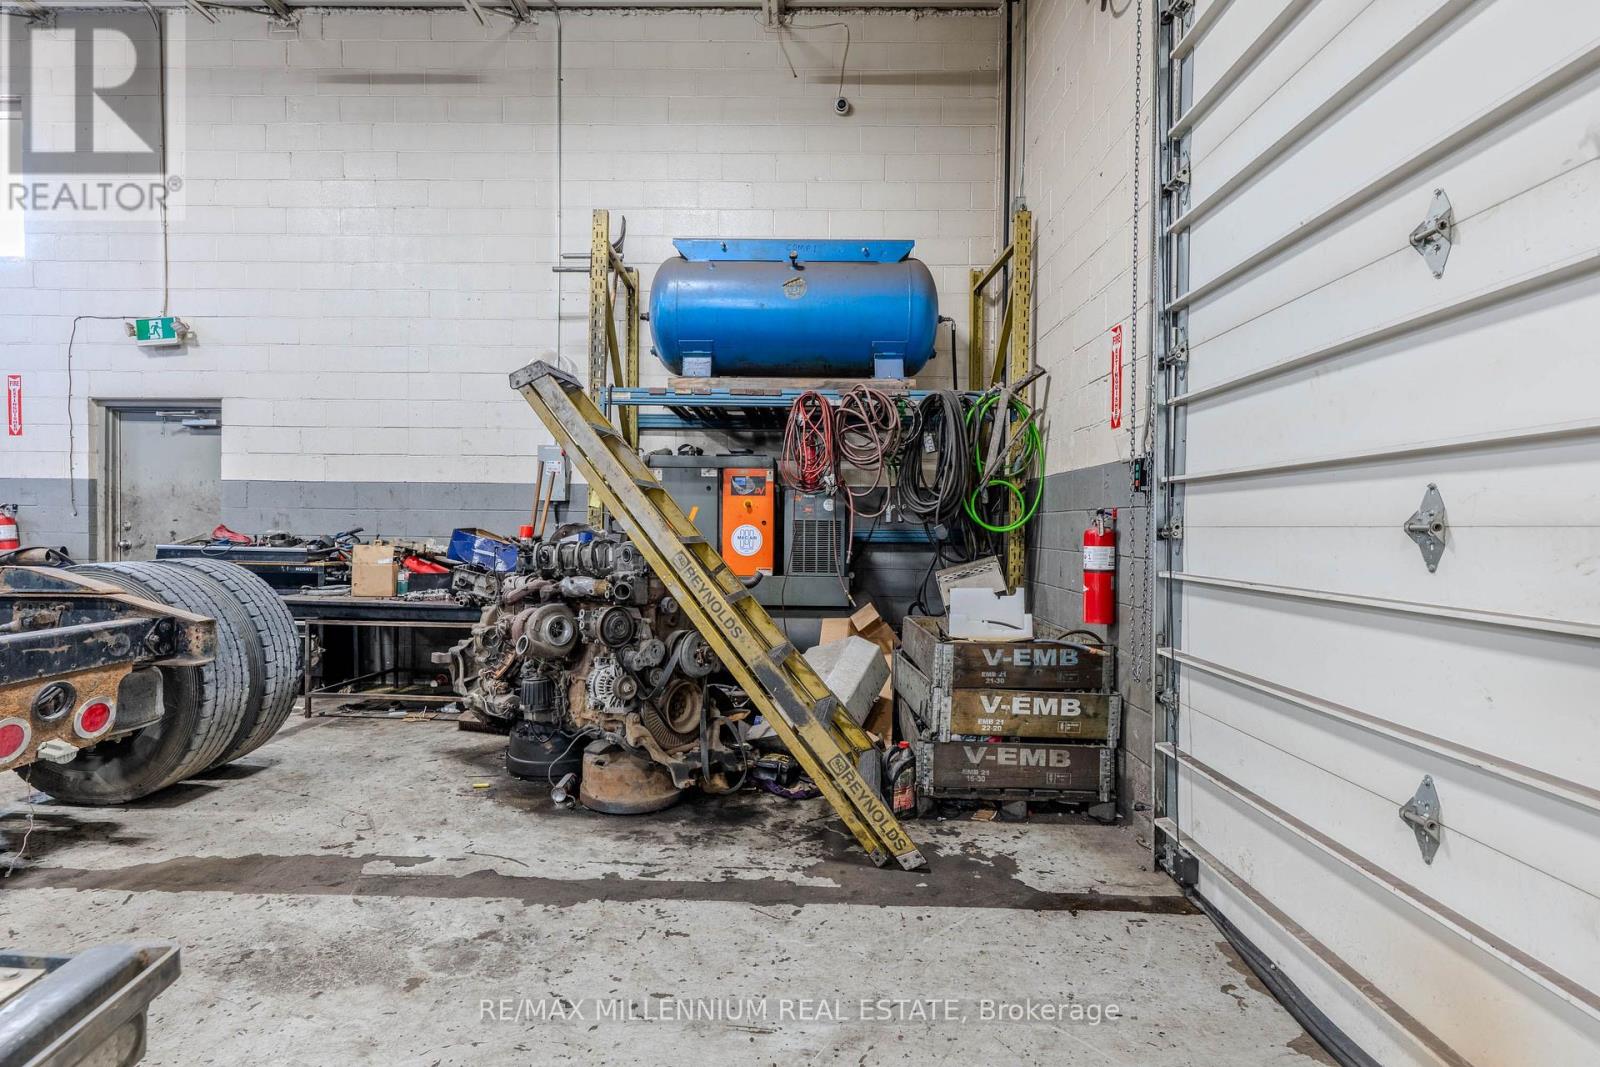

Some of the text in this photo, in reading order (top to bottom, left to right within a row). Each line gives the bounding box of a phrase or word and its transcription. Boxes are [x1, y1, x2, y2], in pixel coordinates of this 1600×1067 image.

[685, 565, 743, 639] REYNOLDS
[982, 648, 1079, 666] V-EMB
[980, 695, 1081, 716] V-EMB
[963, 746, 1071, 767] V-EMB
[842, 767, 907, 851] REYNOLDS
